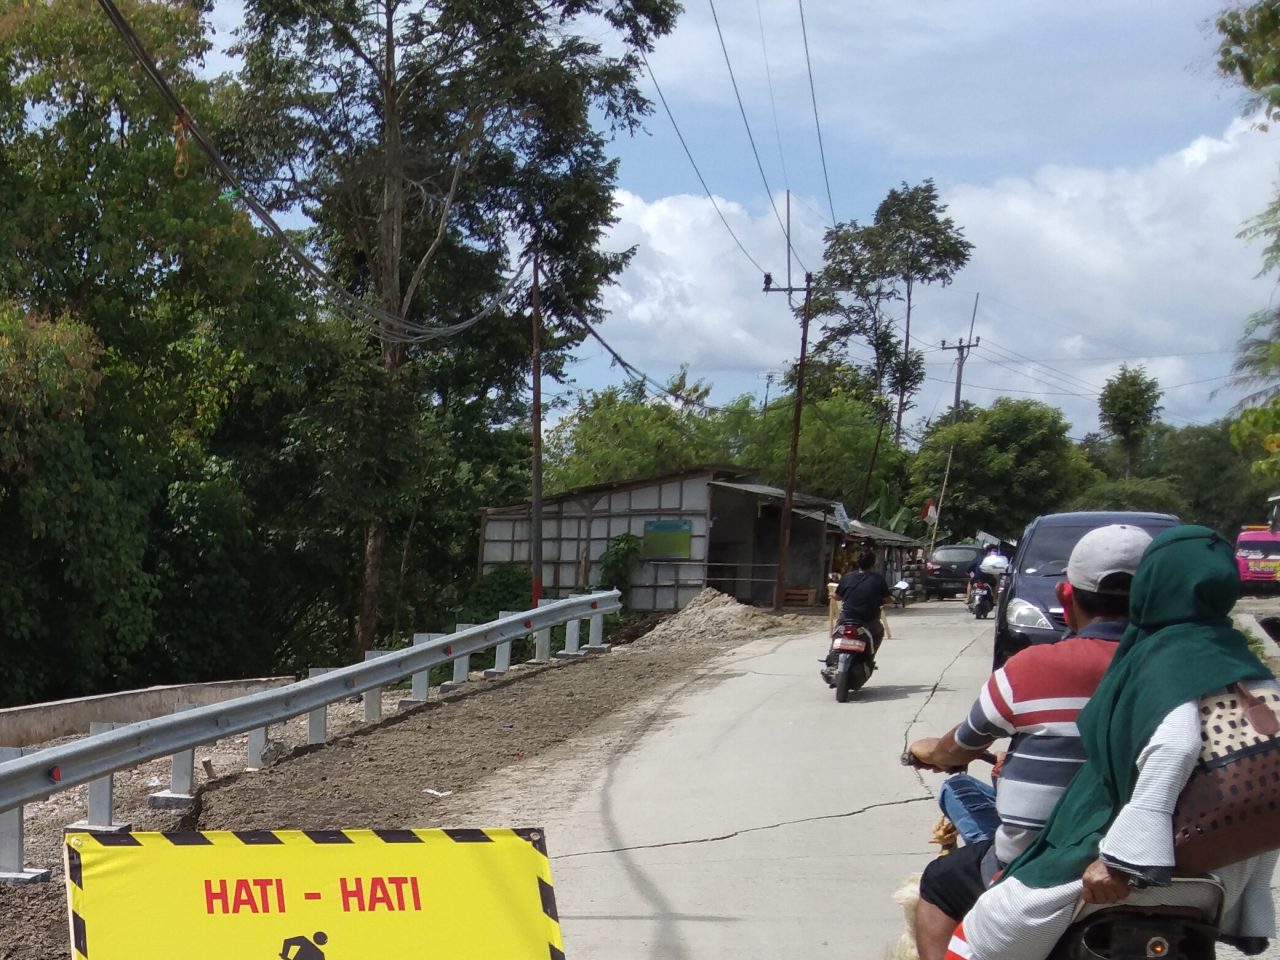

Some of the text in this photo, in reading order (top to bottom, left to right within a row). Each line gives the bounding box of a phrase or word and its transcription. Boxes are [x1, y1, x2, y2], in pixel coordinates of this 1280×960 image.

[205, 877, 422, 914] HATI - HATI
